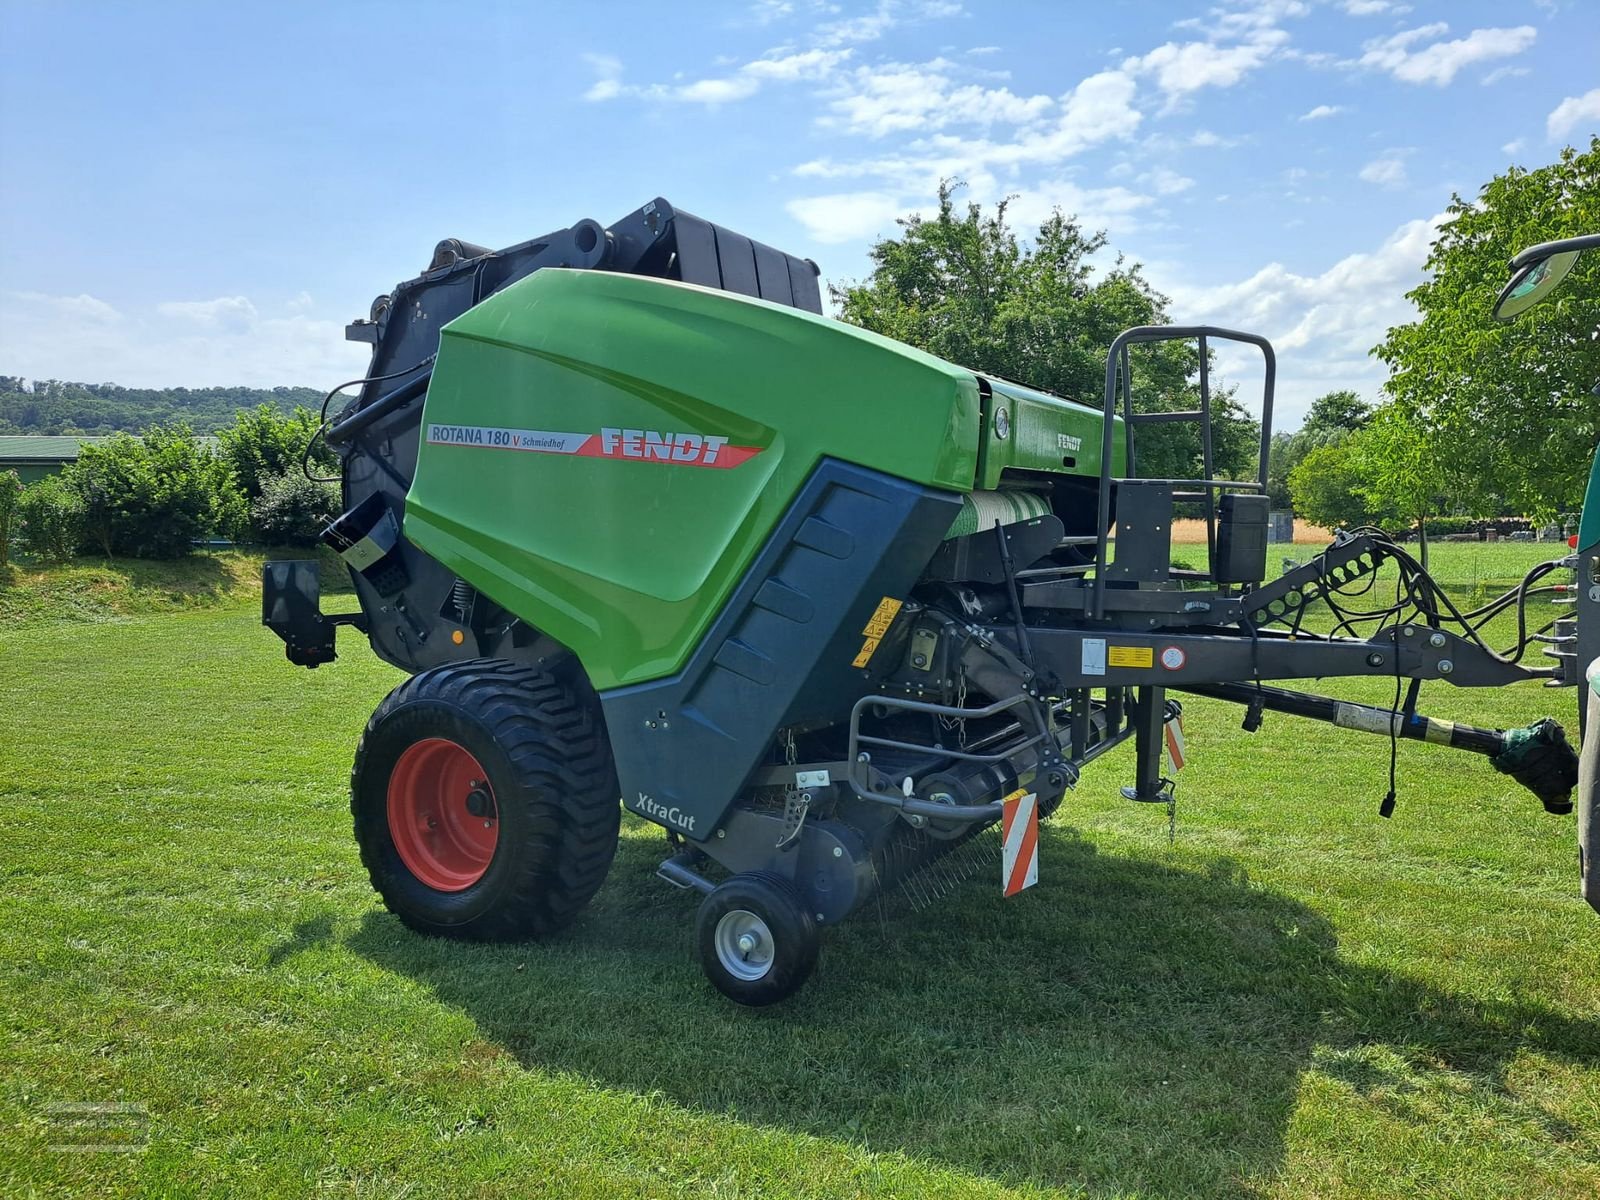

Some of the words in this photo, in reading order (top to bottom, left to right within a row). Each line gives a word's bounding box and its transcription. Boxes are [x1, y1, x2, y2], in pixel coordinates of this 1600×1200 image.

[433, 426, 483, 444] ROTANA
[486, 430, 510, 446] 180
[512, 435, 520, 446] V
[521, 437, 565, 450] Schmiedhof
[600, 427, 729, 464] FENDT
[1057, 433, 1082, 452] FENDT
[635, 792, 696, 831] XtraCut
